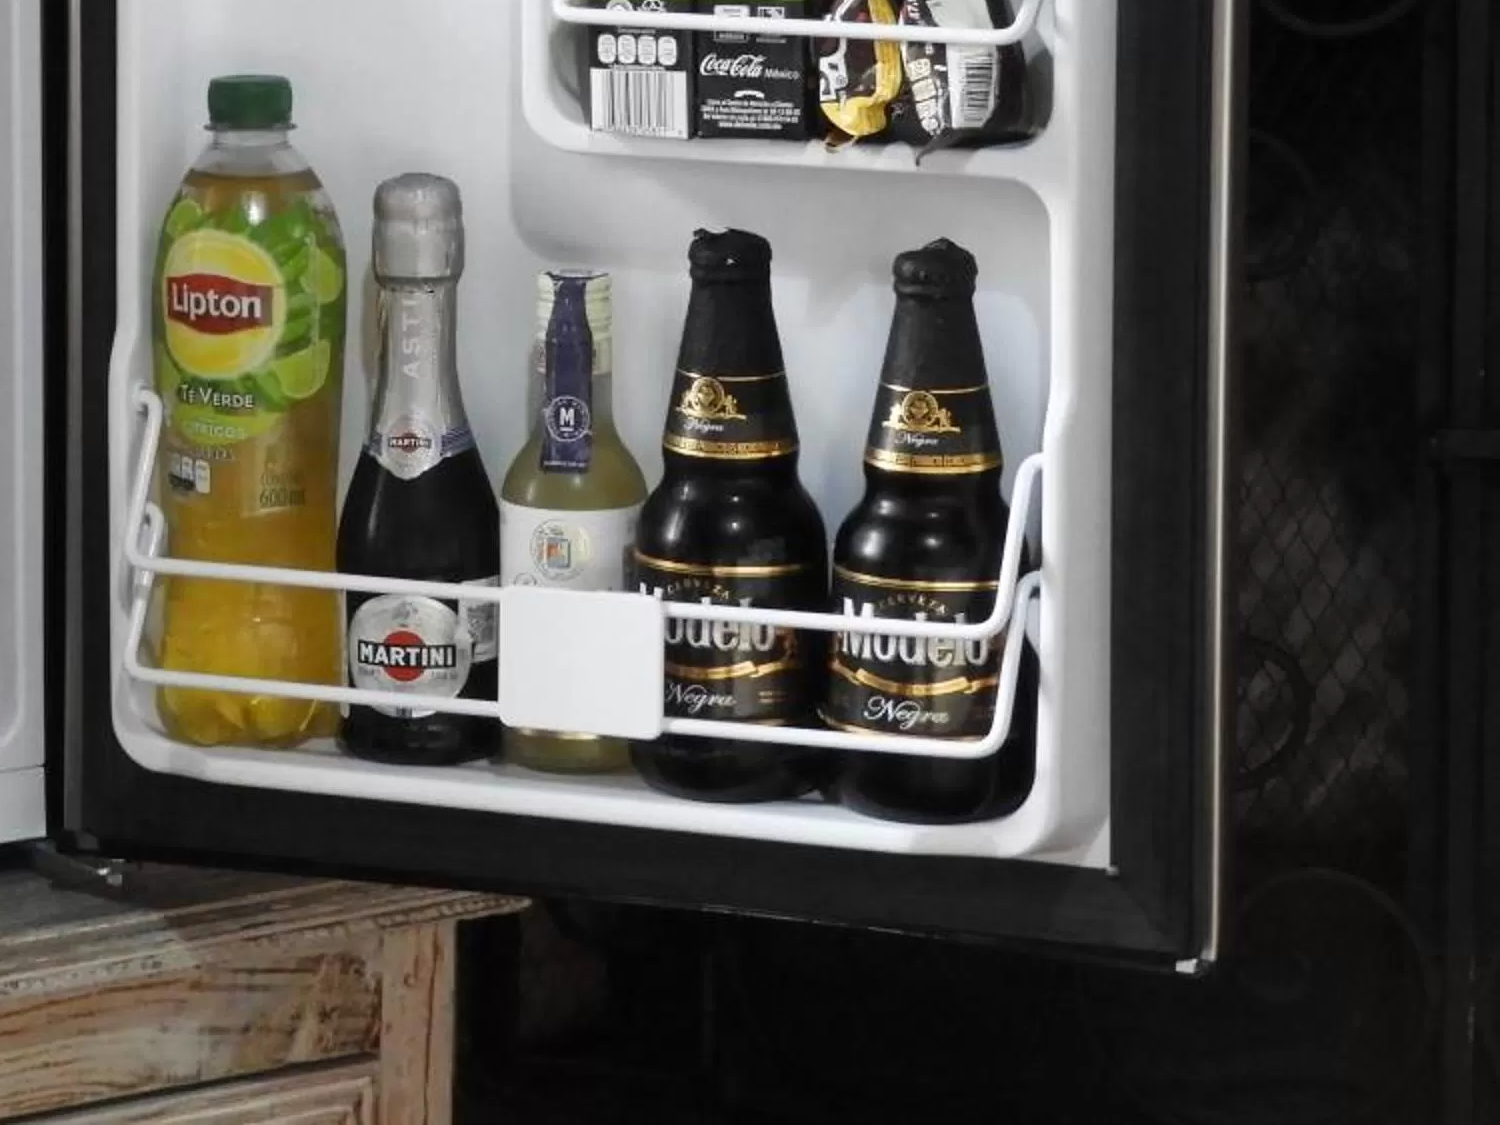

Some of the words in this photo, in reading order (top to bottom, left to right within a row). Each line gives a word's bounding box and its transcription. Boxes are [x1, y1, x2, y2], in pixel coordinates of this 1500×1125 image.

[172, 283, 261, 321] Lipton
[559, 407, 575, 426] M
[388, 438, 432, 448] MARTINI
[841, 597, 990, 668] Modelo
[359, 642, 454, 668] MARTINI
[863, 696, 949, 730] Negra
